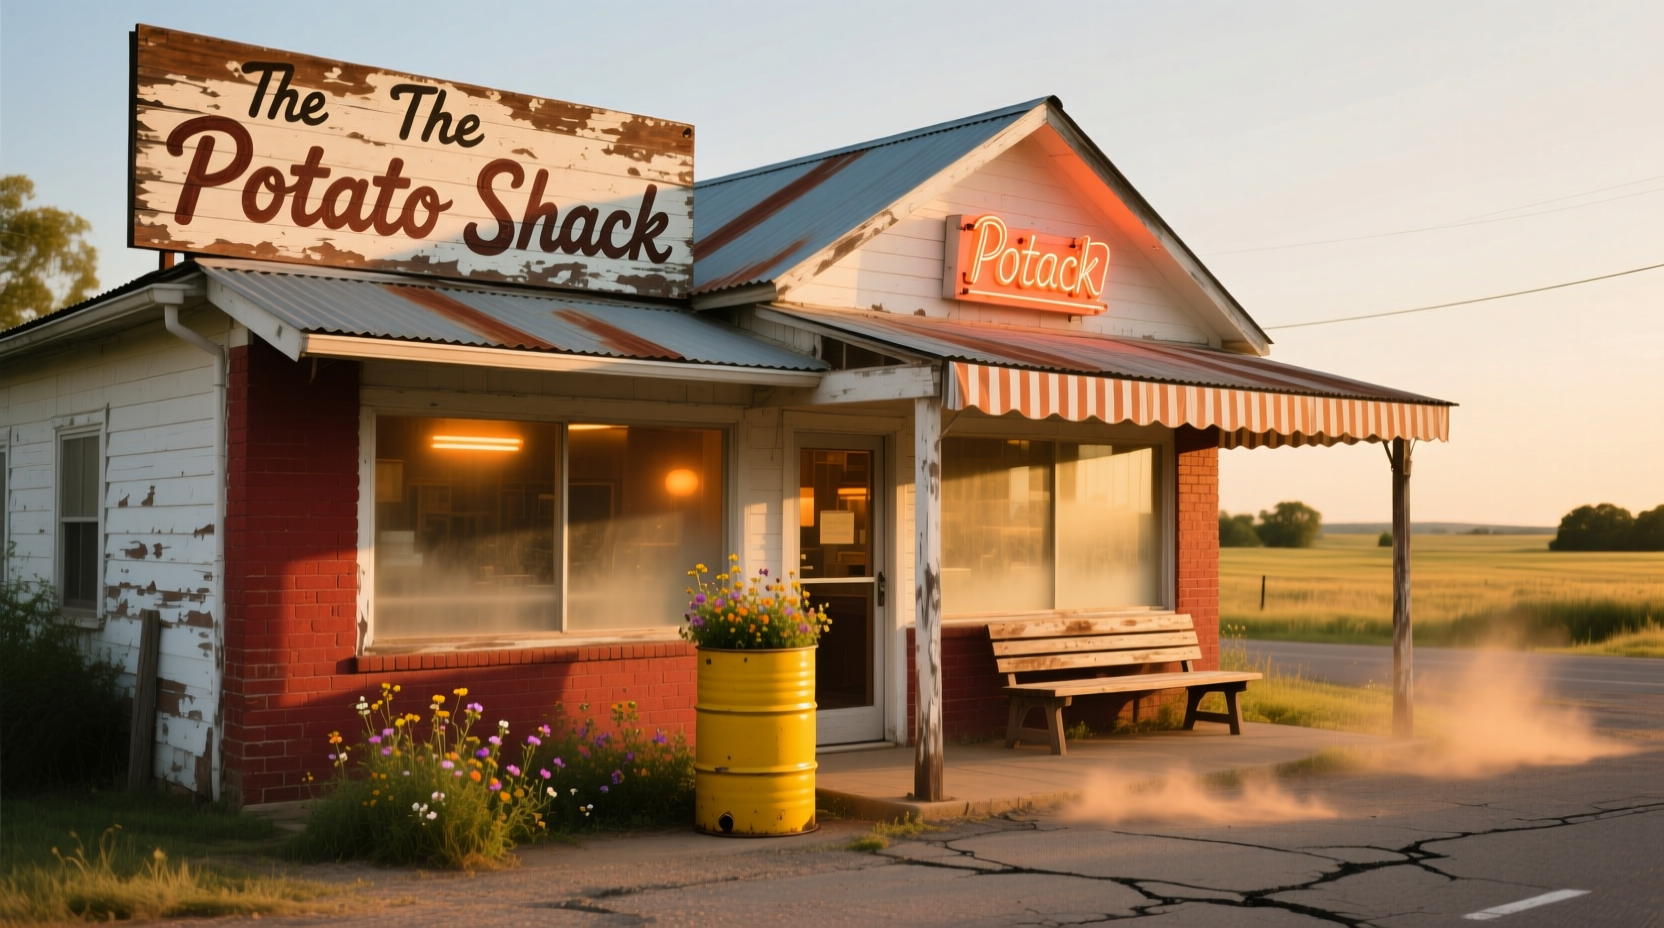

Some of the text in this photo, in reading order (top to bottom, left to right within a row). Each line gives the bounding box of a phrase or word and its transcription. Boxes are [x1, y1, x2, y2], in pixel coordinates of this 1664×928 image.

[241, 61, 485, 148] The The
[166, 115, 673, 264] Potato Shack
[970, 215, 1102, 297] Potack
